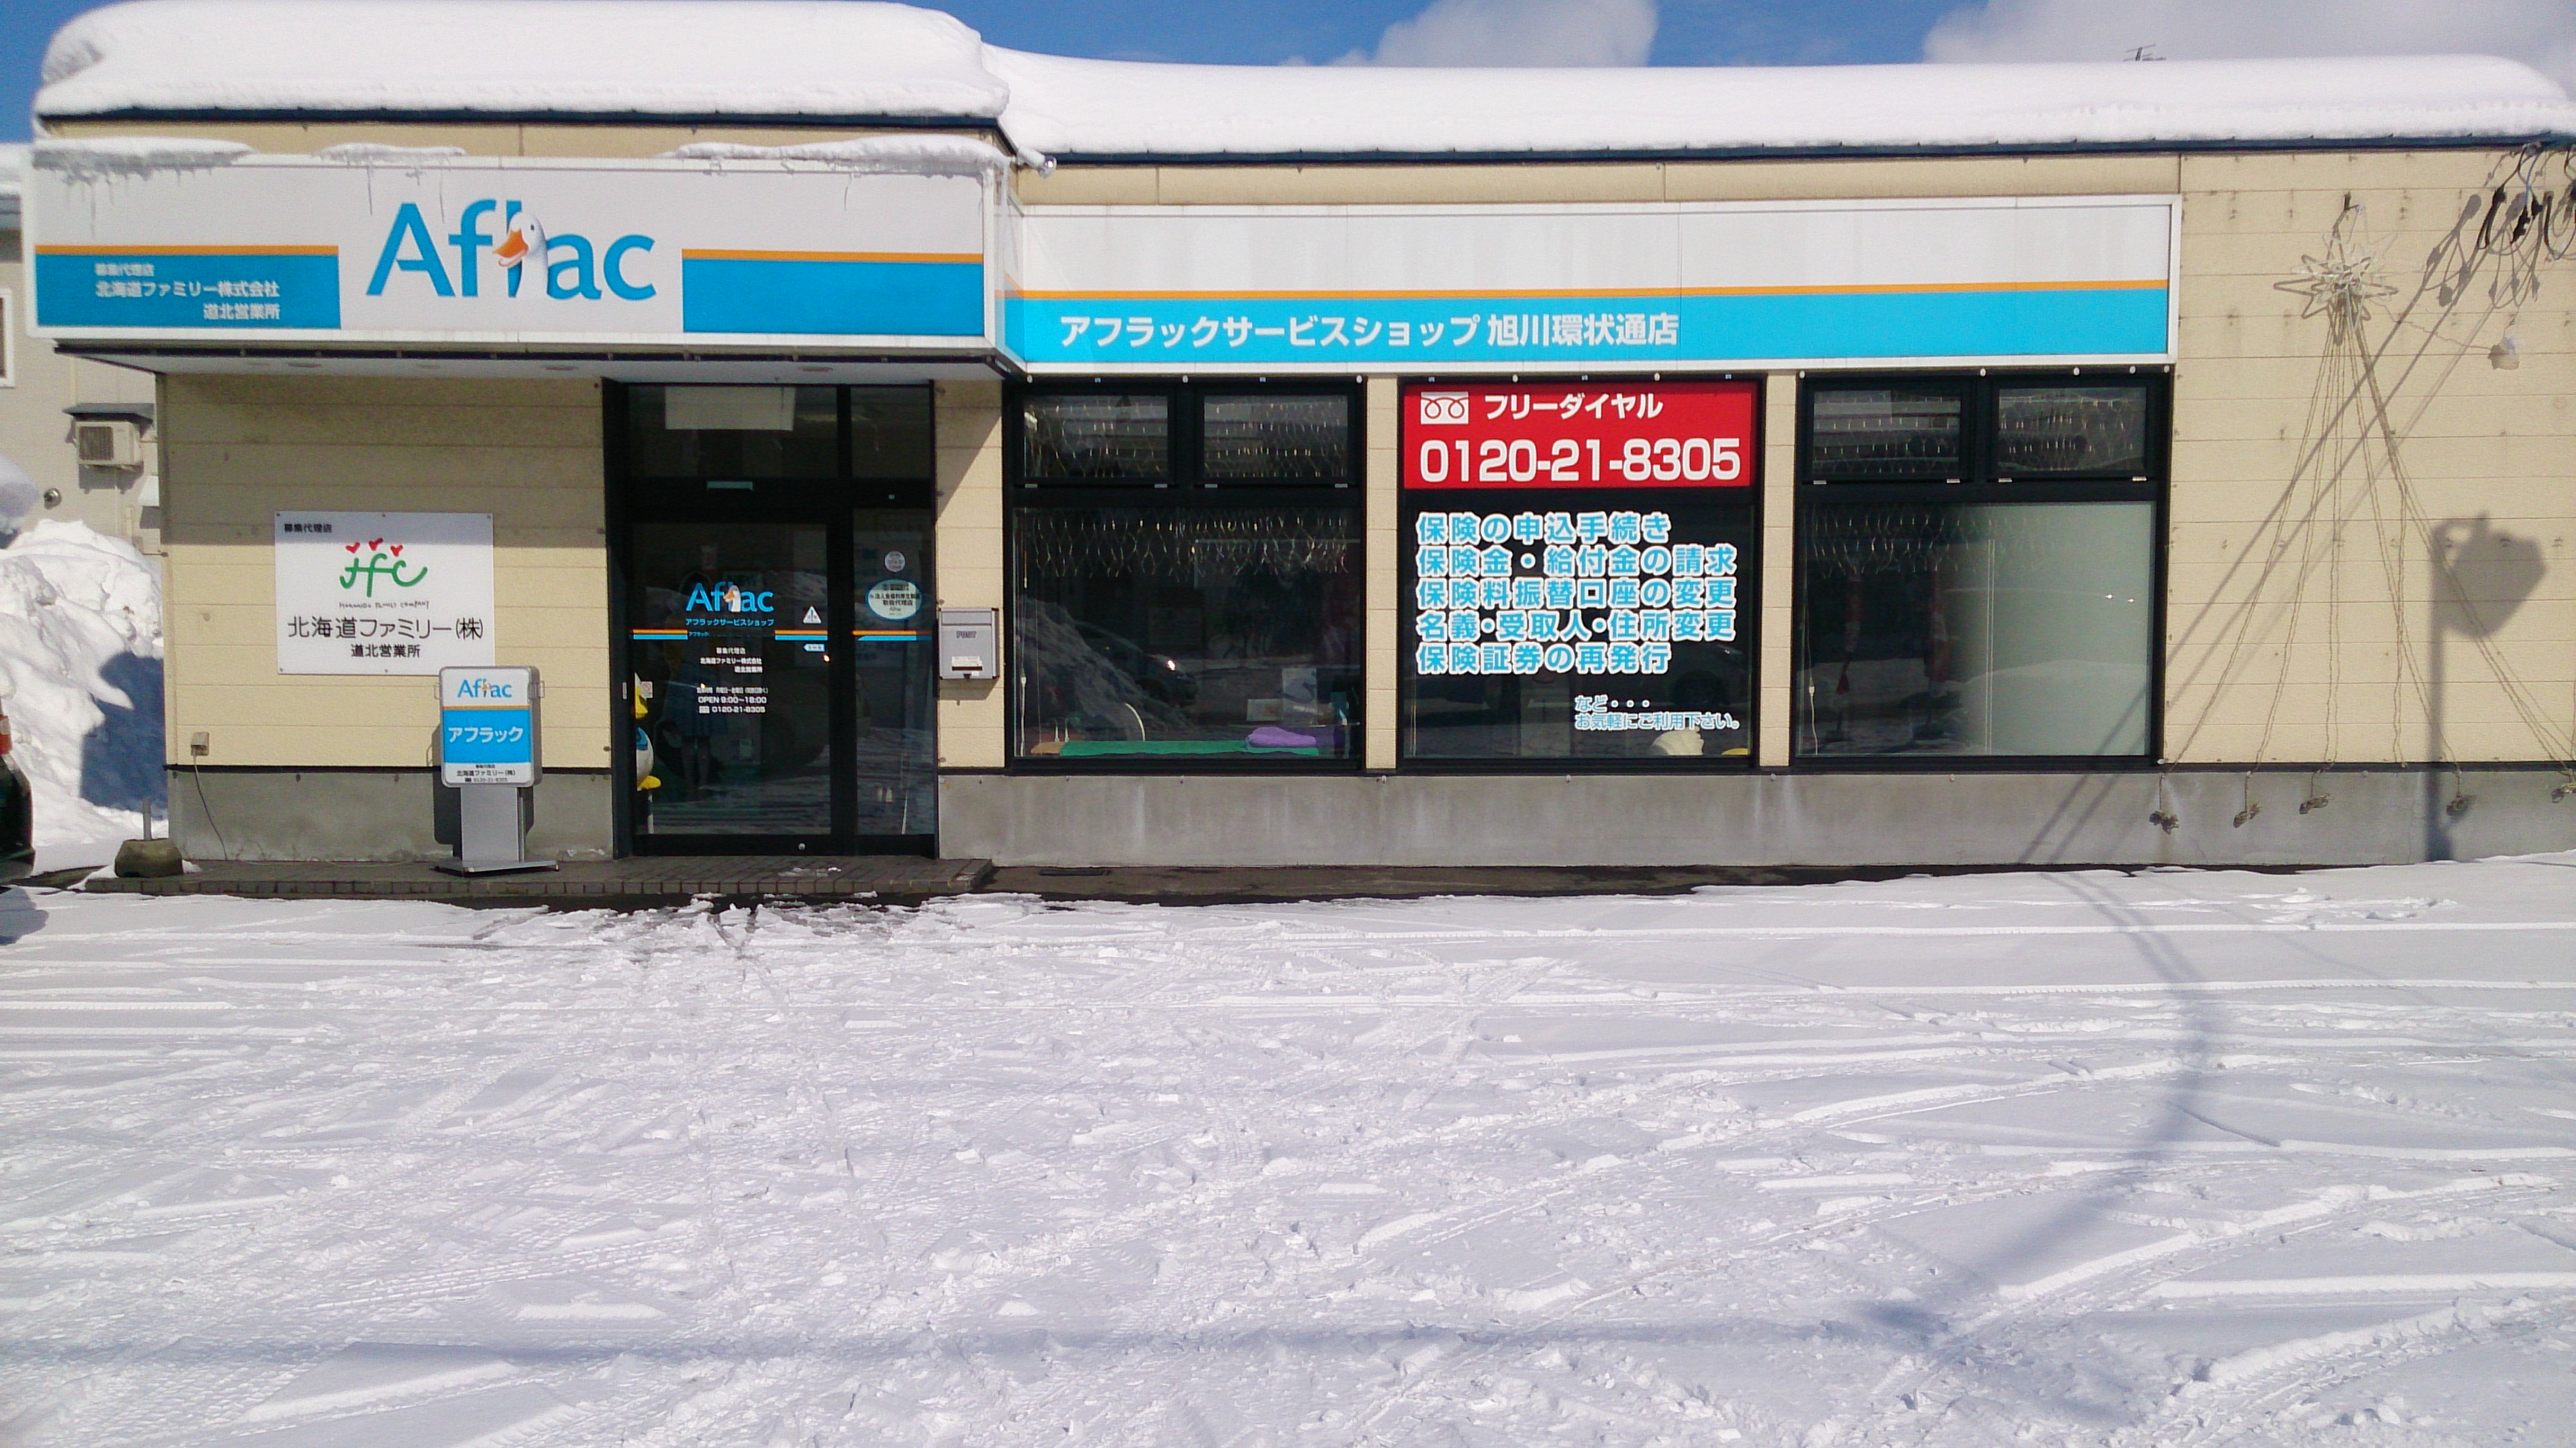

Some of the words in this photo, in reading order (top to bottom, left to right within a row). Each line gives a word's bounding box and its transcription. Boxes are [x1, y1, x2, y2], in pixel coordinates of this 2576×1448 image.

[366, 199, 656, 300] Aflac
[96, 281, 280, 297] 北海道ファミリー株式会社
[203, 303, 280, 320] 道北営業所
[1061, 314, 1481, 348] アフラックサービスショップ
[1487, 313, 1679, 346] 旭川環状通店
[1484, 393, 1663, 419] フリーダイヤル
[1420, 438, 1740, 482] 0120-21-8305
[1416, 512, 1672, 545] 保険の申込手続き
[1416, 543, 1737, 577] 保険金・給付金の請求
[685, 581, 774, 612] Aflac
[1416, 576, 1737, 610] 保険料振替口座の変更
[288, 616, 484, 640] 北海道ファミリー(株)
[1416, 608, 1736, 642] 名義・受取人・住所変更
[350, 644, 421, 658] 道北営業所
[1416, 641, 1672, 675] 保険証券の再発行
[457, 678, 513, 698] Aflac
[448, 726, 524, 743] アフラック
[1575, 712, 1740, 731] お気軽にご利用下さい。
